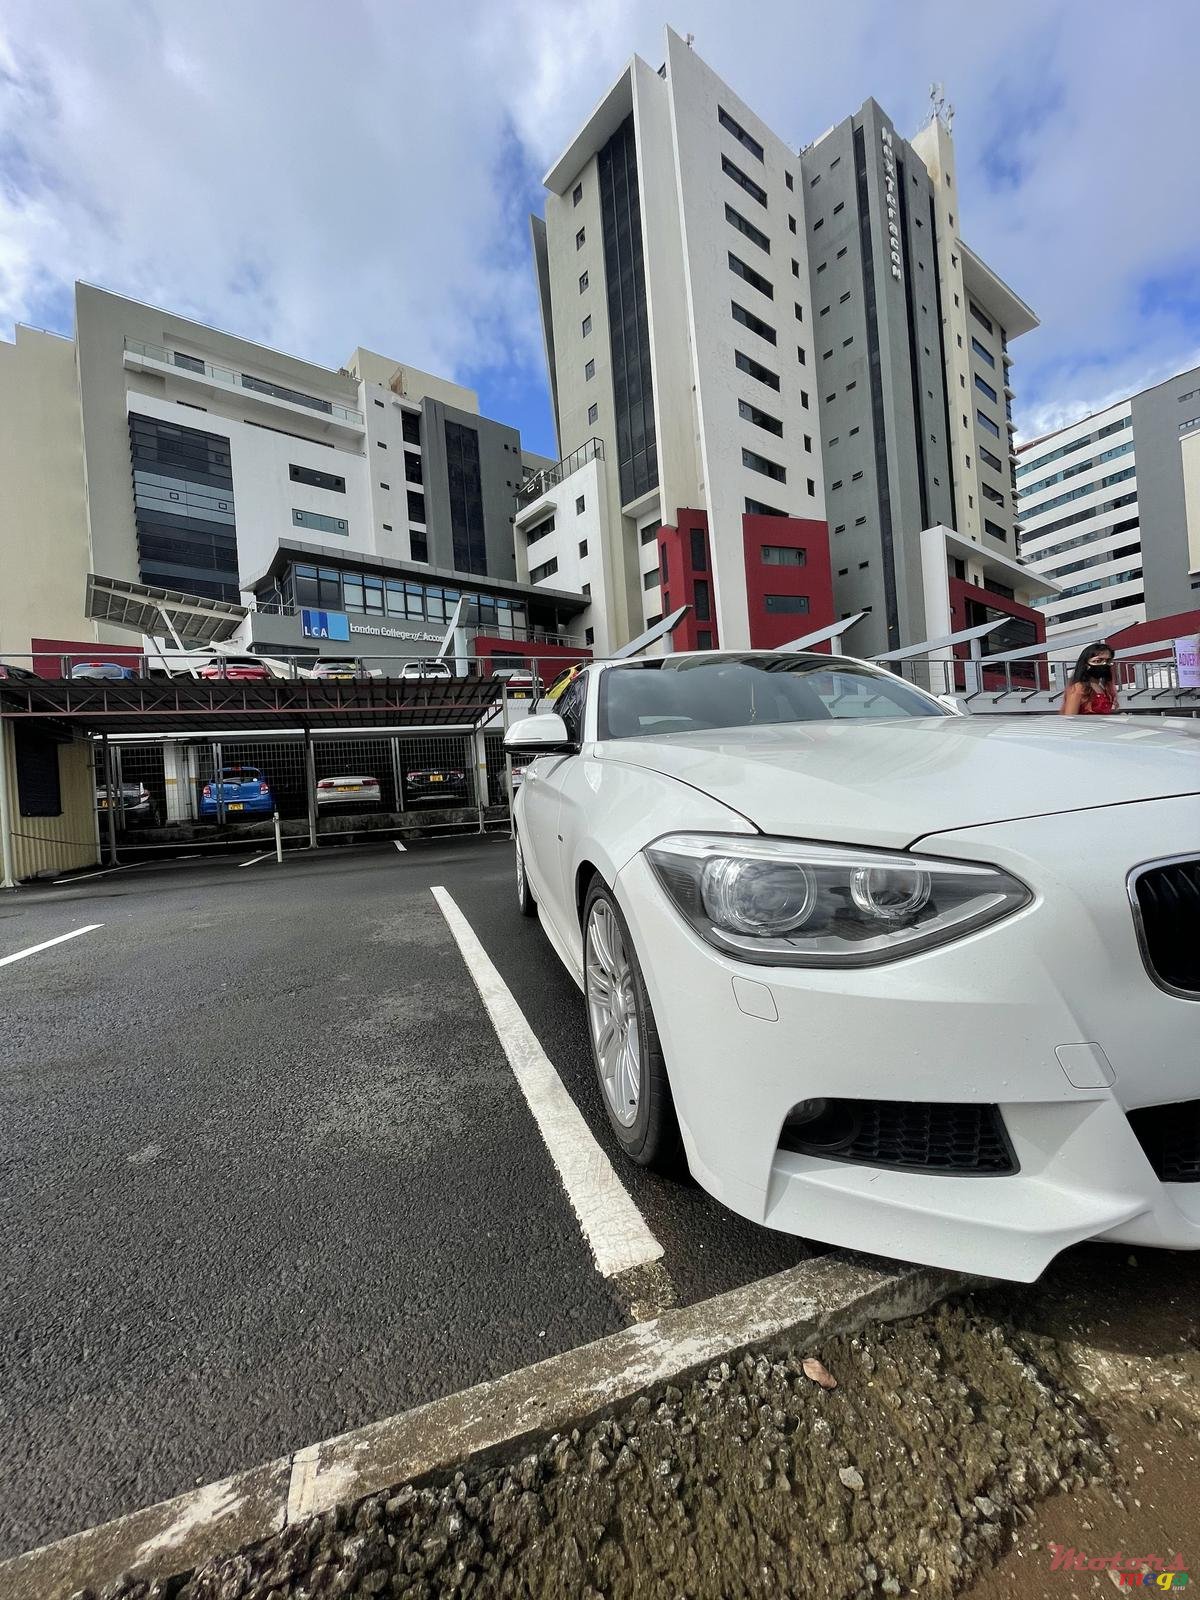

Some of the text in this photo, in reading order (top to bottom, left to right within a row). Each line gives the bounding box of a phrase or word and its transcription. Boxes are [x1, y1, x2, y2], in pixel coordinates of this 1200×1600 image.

[304, 626, 328, 638] LCA
[350, 623, 380, 636] London
[381, 627, 411, 641] College
[423, 632, 446, 643] Accou
